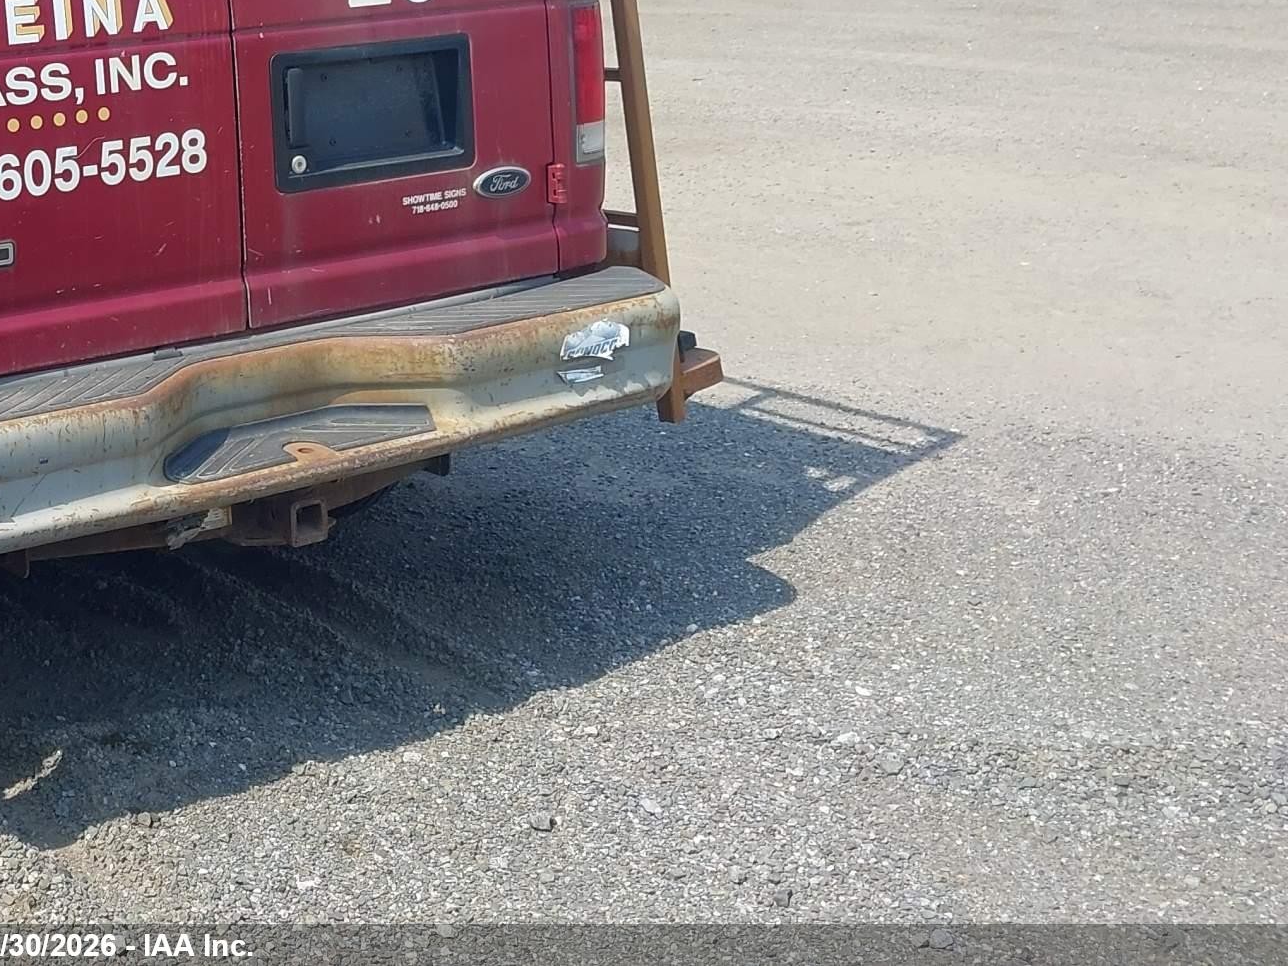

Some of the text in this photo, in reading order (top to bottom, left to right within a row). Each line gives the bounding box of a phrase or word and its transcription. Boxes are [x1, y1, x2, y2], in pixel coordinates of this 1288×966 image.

[95, 52, 188, 96] INC.
[402, 187, 467, 206] SHOWTIME SIGNS
